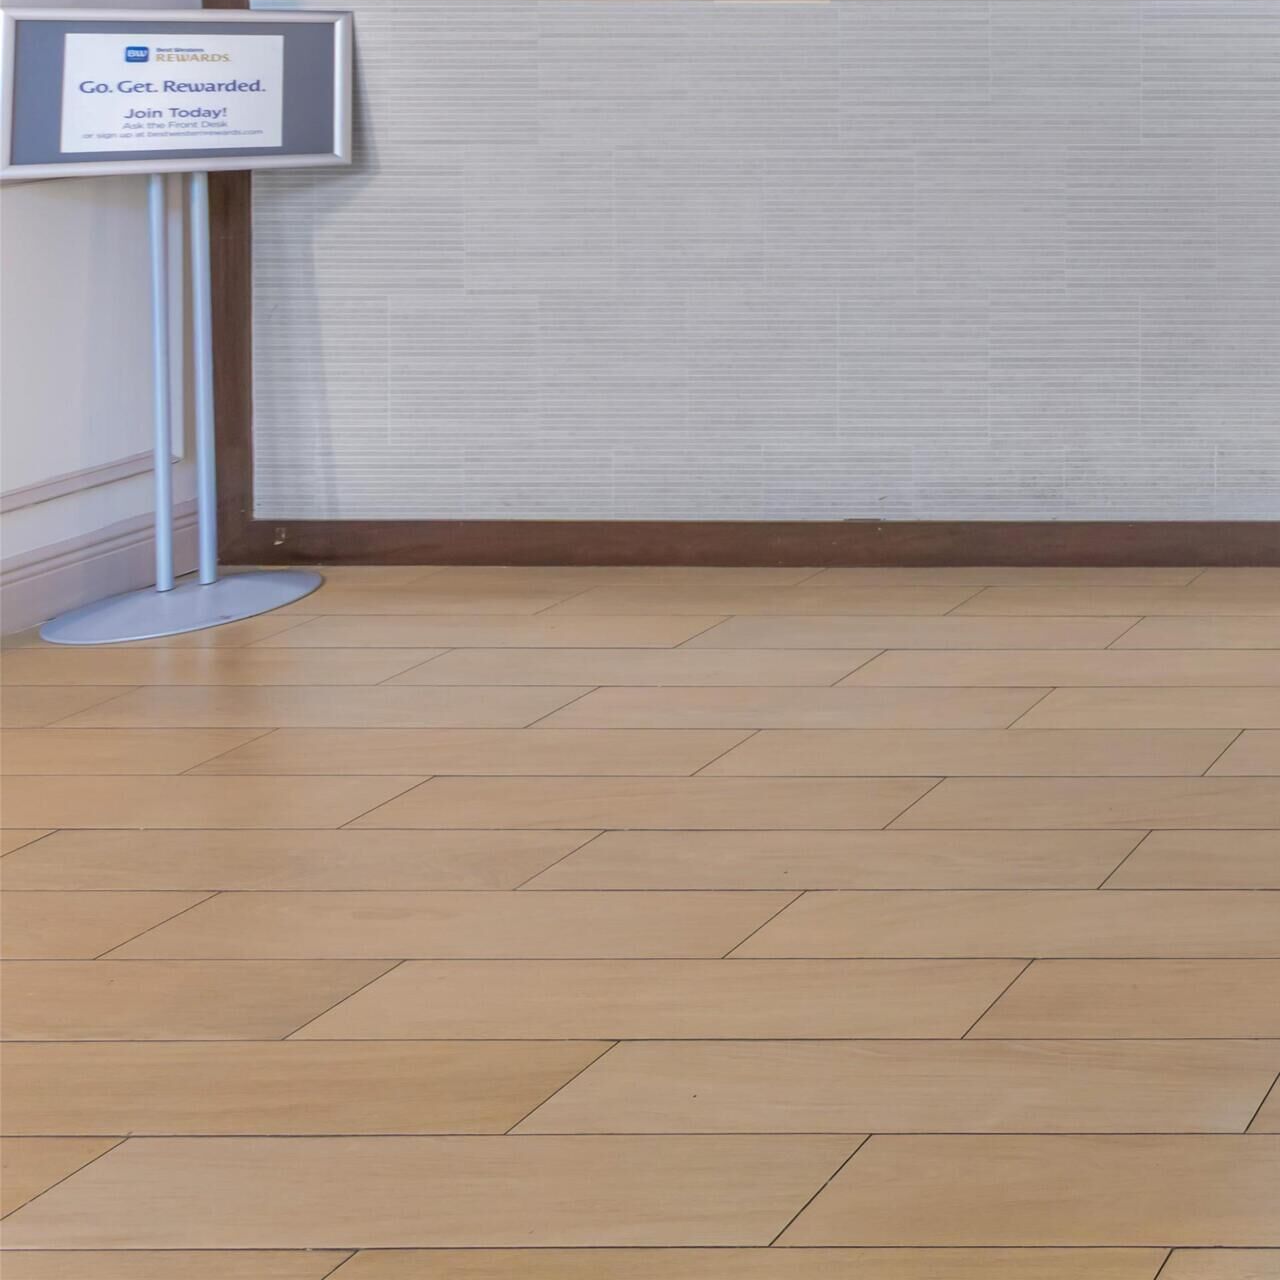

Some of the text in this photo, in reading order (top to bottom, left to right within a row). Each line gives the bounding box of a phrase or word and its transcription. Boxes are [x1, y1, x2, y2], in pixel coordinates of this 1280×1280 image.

[78, 79, 267, 94] Go. Get. Rewarded.
[123, 107, 228, 119] Join Today!
[121, 120, 228, 130] Ask the Front Desk
[96, 131, 117, 139] sign
